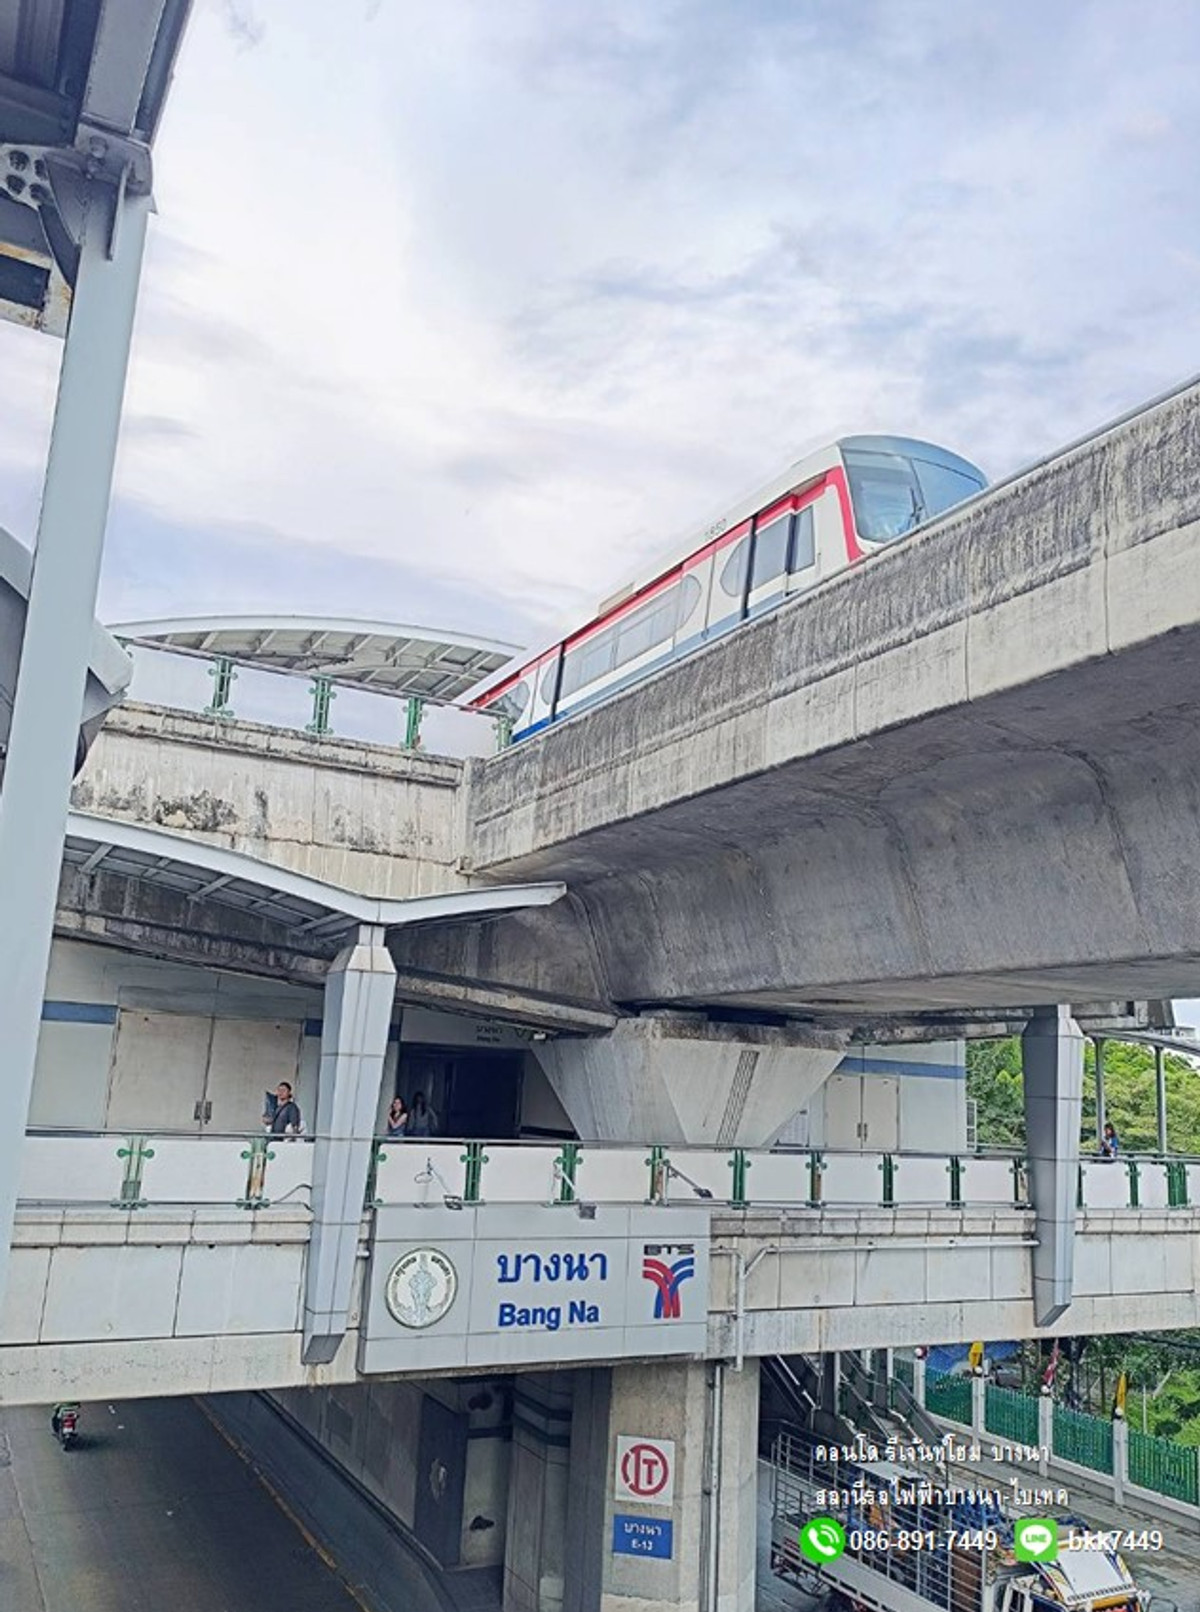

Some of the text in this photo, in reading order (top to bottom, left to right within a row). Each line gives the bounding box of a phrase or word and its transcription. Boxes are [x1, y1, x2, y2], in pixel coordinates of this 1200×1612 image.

[644, 1244, 694, 1255] BTS
[497, 1252, 608, 1283] บางนา
[498, 1301, 600, 1330] Bang Na
[624, 1522, 662, 1536] บางนา
